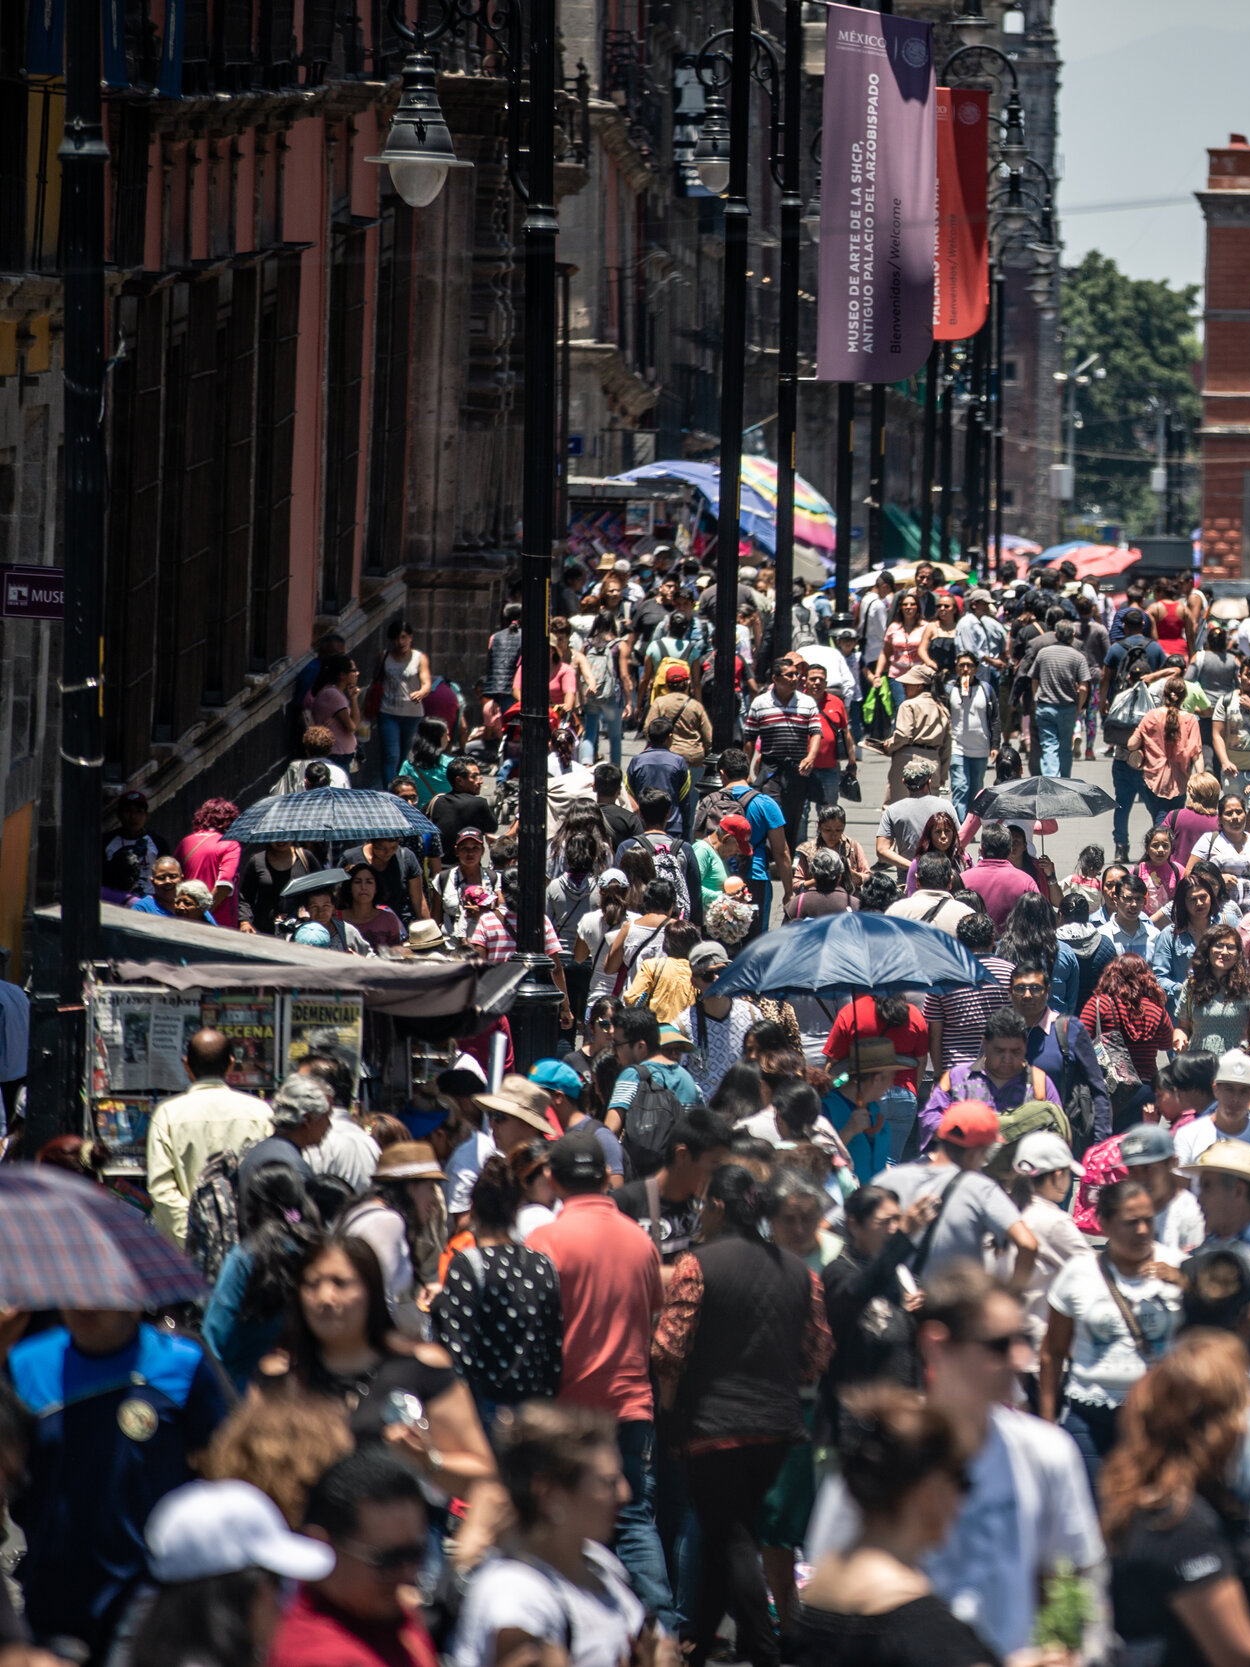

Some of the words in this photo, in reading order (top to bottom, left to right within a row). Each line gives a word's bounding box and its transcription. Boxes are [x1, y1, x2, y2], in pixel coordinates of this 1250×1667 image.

[838, 30, 887, 49] MÉXICO
[865, 73, 880, 182] ARZOBISPADO
[851, 141, 865, 183] SHCP,
[851, 187, 862, 206] LA
[865, 184, 875, 213] DEL
[850, 210, 861, 230] DE
[850, 234, 861, 273] ARTE
[863, 216, 875, 281] PALACIO
[849, 276, 860, 296] DE
[932, 260, 941, 325] PALACIO
[848, 300, 860, 353] MUSEO
[862, 285, 874, 354] ANTIGUO
